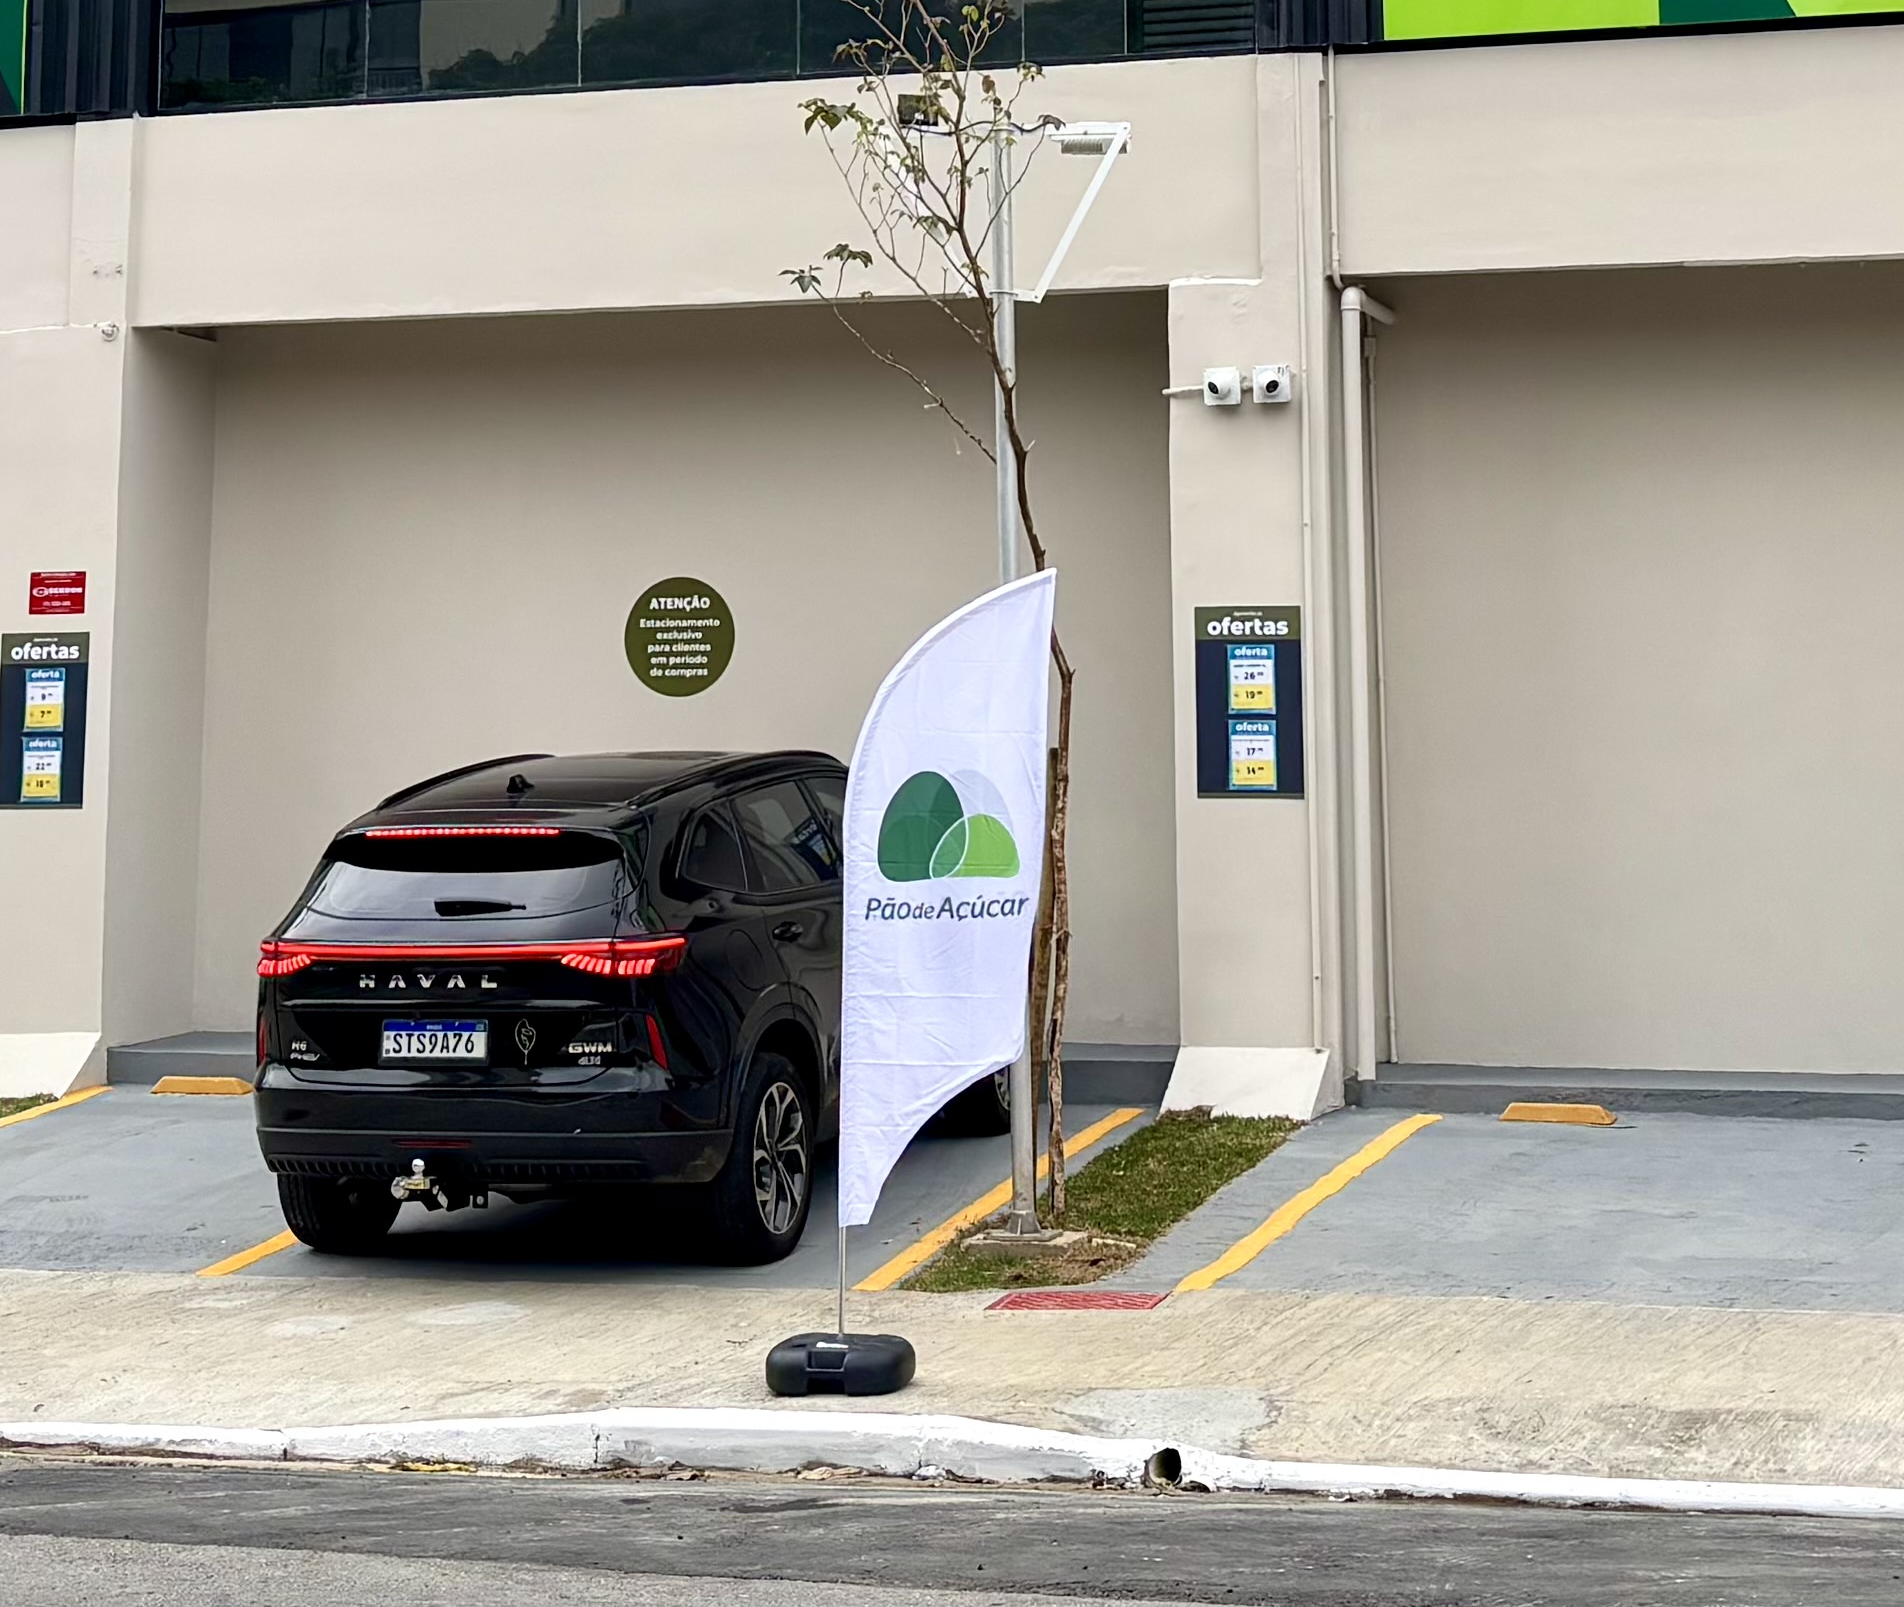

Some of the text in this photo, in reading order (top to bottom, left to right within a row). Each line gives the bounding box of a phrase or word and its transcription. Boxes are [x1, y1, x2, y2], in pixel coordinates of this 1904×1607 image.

[649, 594, 711, 612] ATENÇÃO
[639, 618, 721, 628] Estacionamento
[1207, 616, 1289, 636] ofertas
[656, 629, 703, 640] exclusivo
[11, 642, 80, 660] ofertas
[647, 642, 712, 653] para clientes
[1234, 646, 1268, 656] oferta
[650, 656, 667, 665] em
[664, 668, 709, 678] compras
[1235, 722, 1270, 732] oferta
[864, 895, 1030, 922] Pão de Açúcar
[359, 974, 498, 989] HAVAL
[392, 1033, 475, 1054] STS9A76
[568, 1042, 613, 1054] GWM
